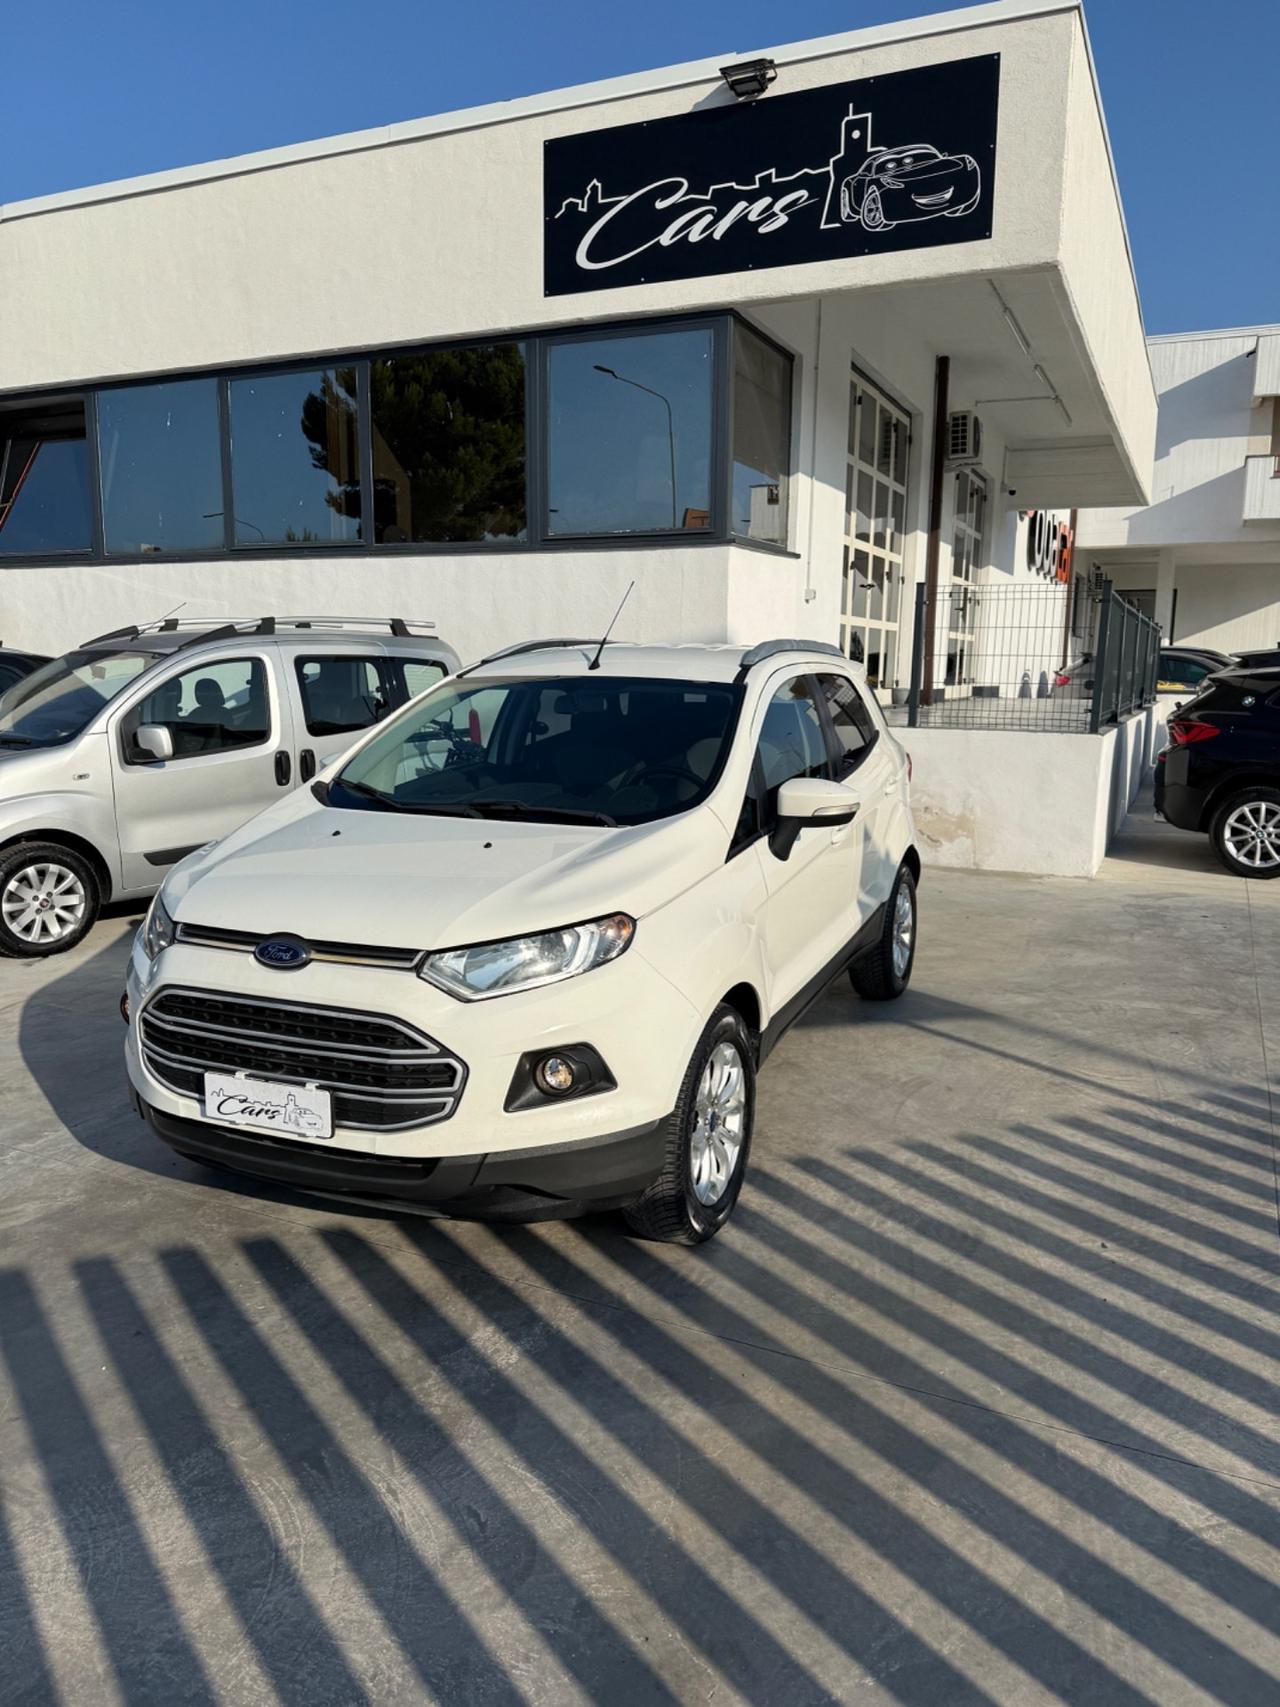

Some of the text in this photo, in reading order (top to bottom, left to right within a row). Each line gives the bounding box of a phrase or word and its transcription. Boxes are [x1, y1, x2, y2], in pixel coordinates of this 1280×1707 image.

[575, 177, 819, 270] Cars
[264, 944, 294, 960] Ford
[217, 1093, 282, 1120] Cars
